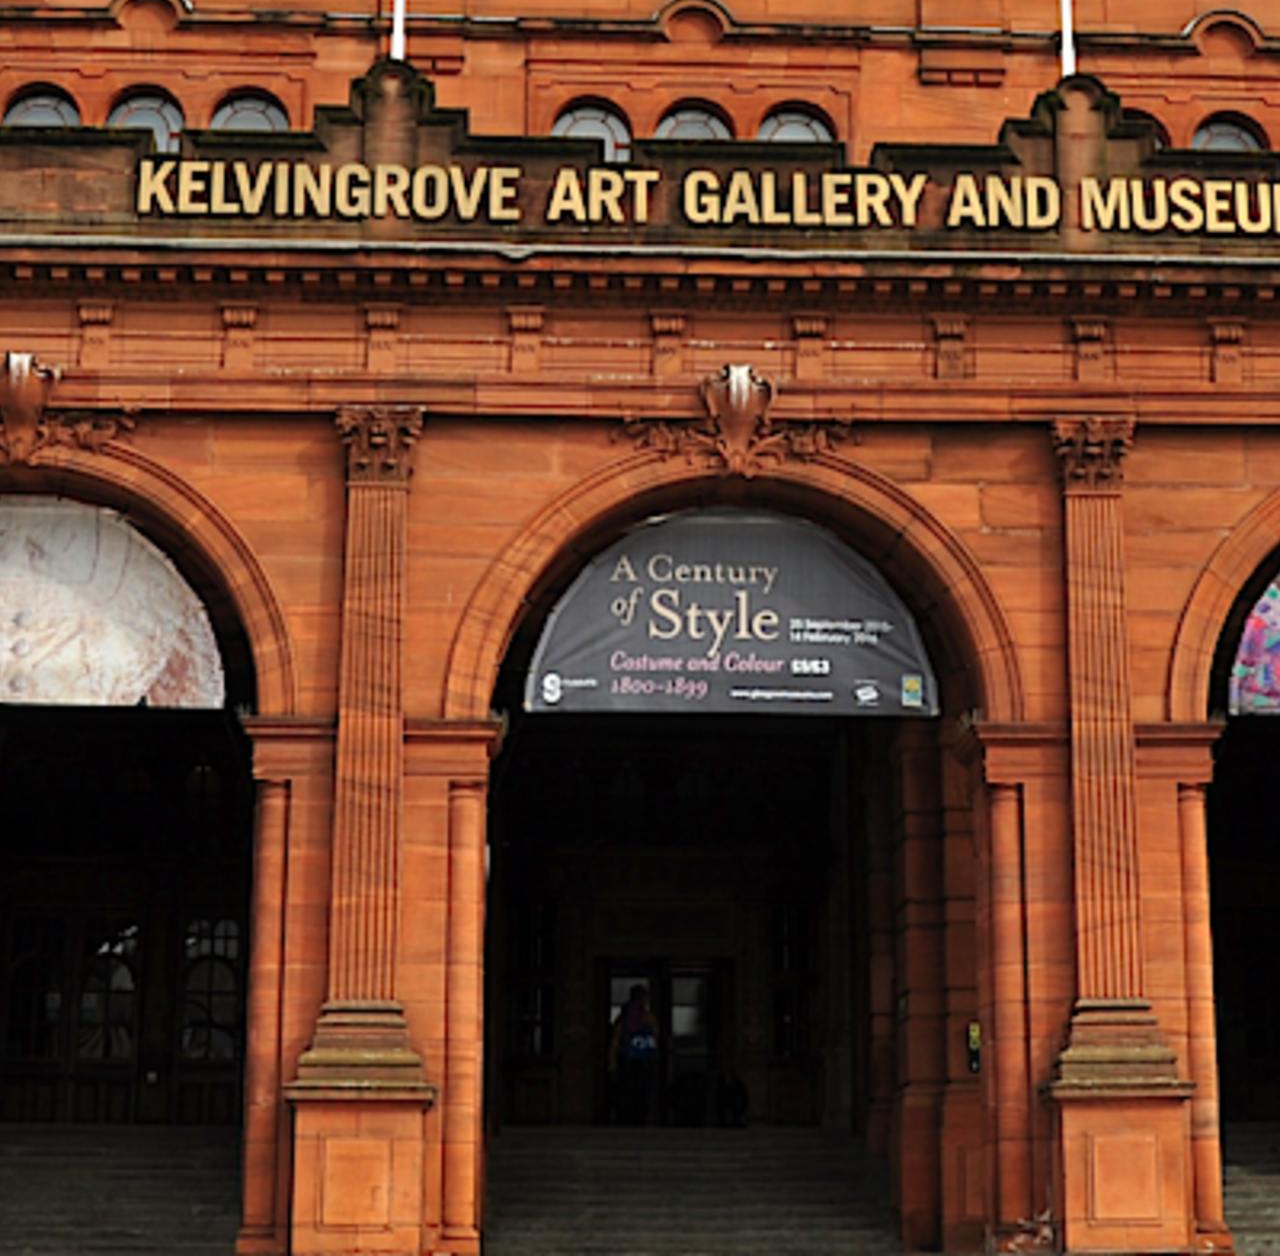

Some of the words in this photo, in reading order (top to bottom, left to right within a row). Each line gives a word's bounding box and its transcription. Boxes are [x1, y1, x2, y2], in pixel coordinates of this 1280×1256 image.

[137, 160, 521, 220] KELVINGROVE
[547, 169, 660, 222] ART
[684, 171, 926, 226] GALLERY
[948, 175, 1060, 228] AND
[610, 555, 638, 582] A
[647, 553, 779, 593] Century
[610, 587, 643, 627] of
[649, 588, 780, 658] Style
[610, 650, 683, 671] Costume
[687, 650, 719, 672] and
[723, 650, 785, 673] Colour
